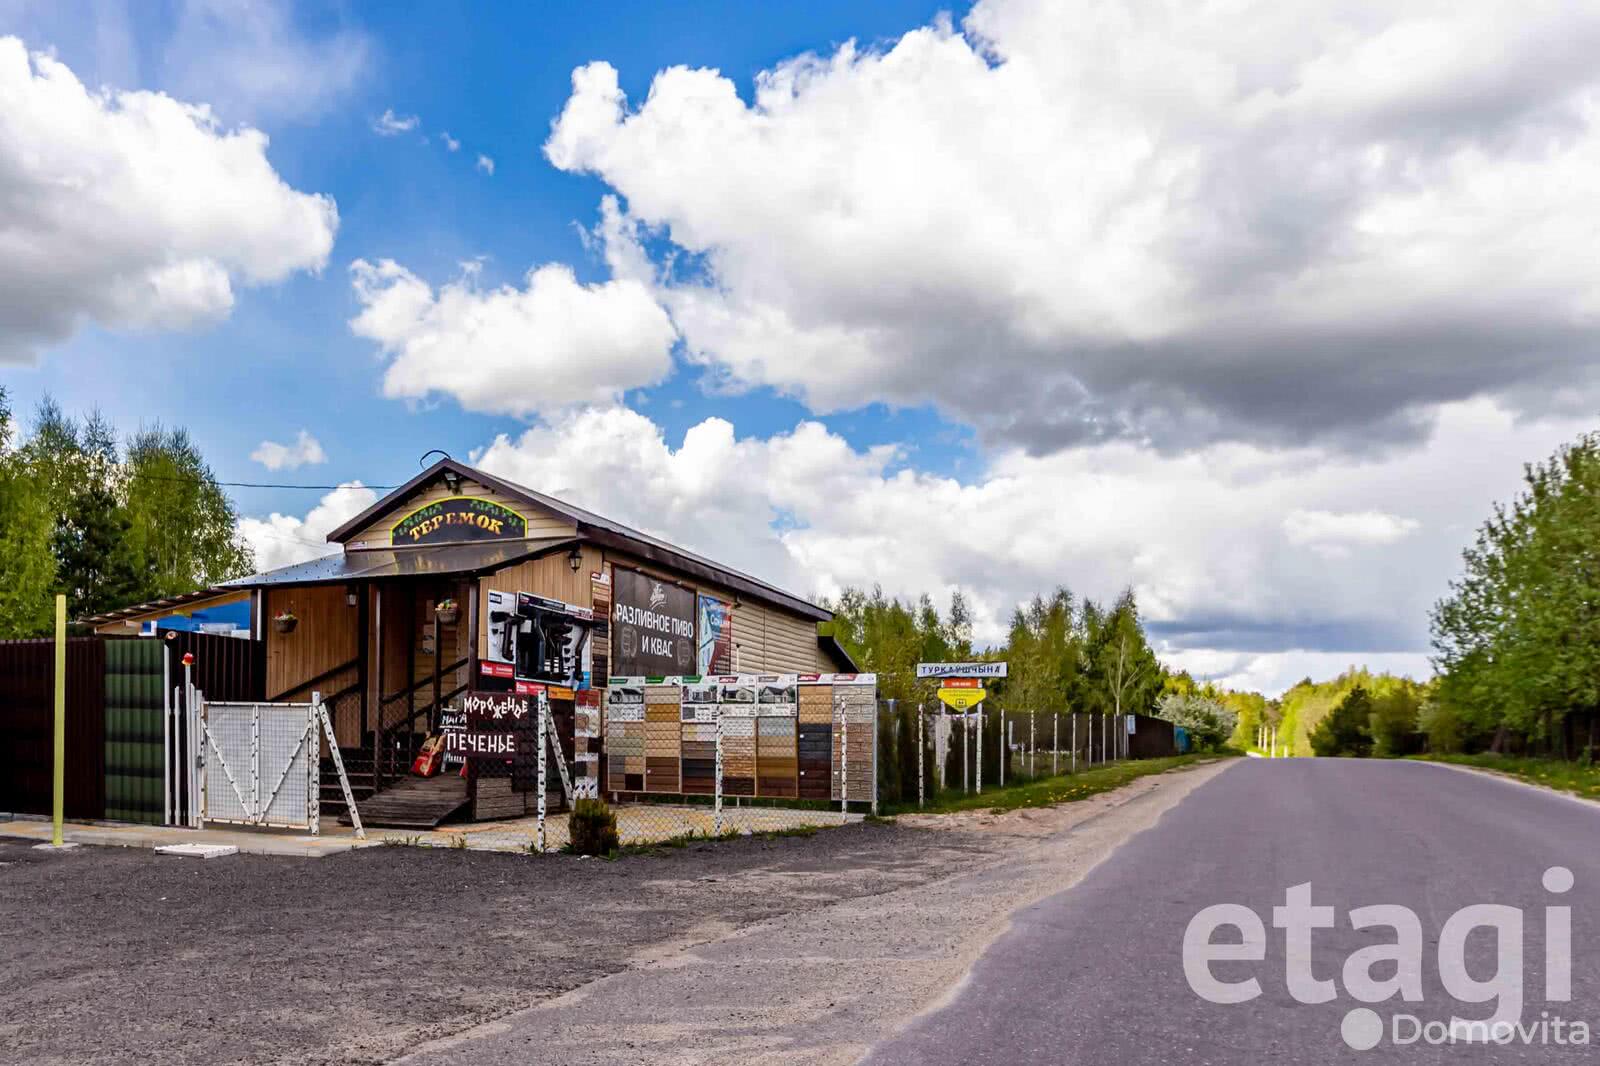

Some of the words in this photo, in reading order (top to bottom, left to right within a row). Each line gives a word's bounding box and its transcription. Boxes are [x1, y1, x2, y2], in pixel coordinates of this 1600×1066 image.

[409, 512, 504, 540] ТЕРЕМОК
[616, 603, 670, 633] РАЗЛИВНОЕ
[671, 617, 694, 639] ПИВО
[641, 635, 649, 653] И
[650, 638, 673, 657] КВАС
[463, 696, 528, 719] МОРОЖЕНОЕ
[447, 733, 515, 754] ПЕЧЕНЬЕ
